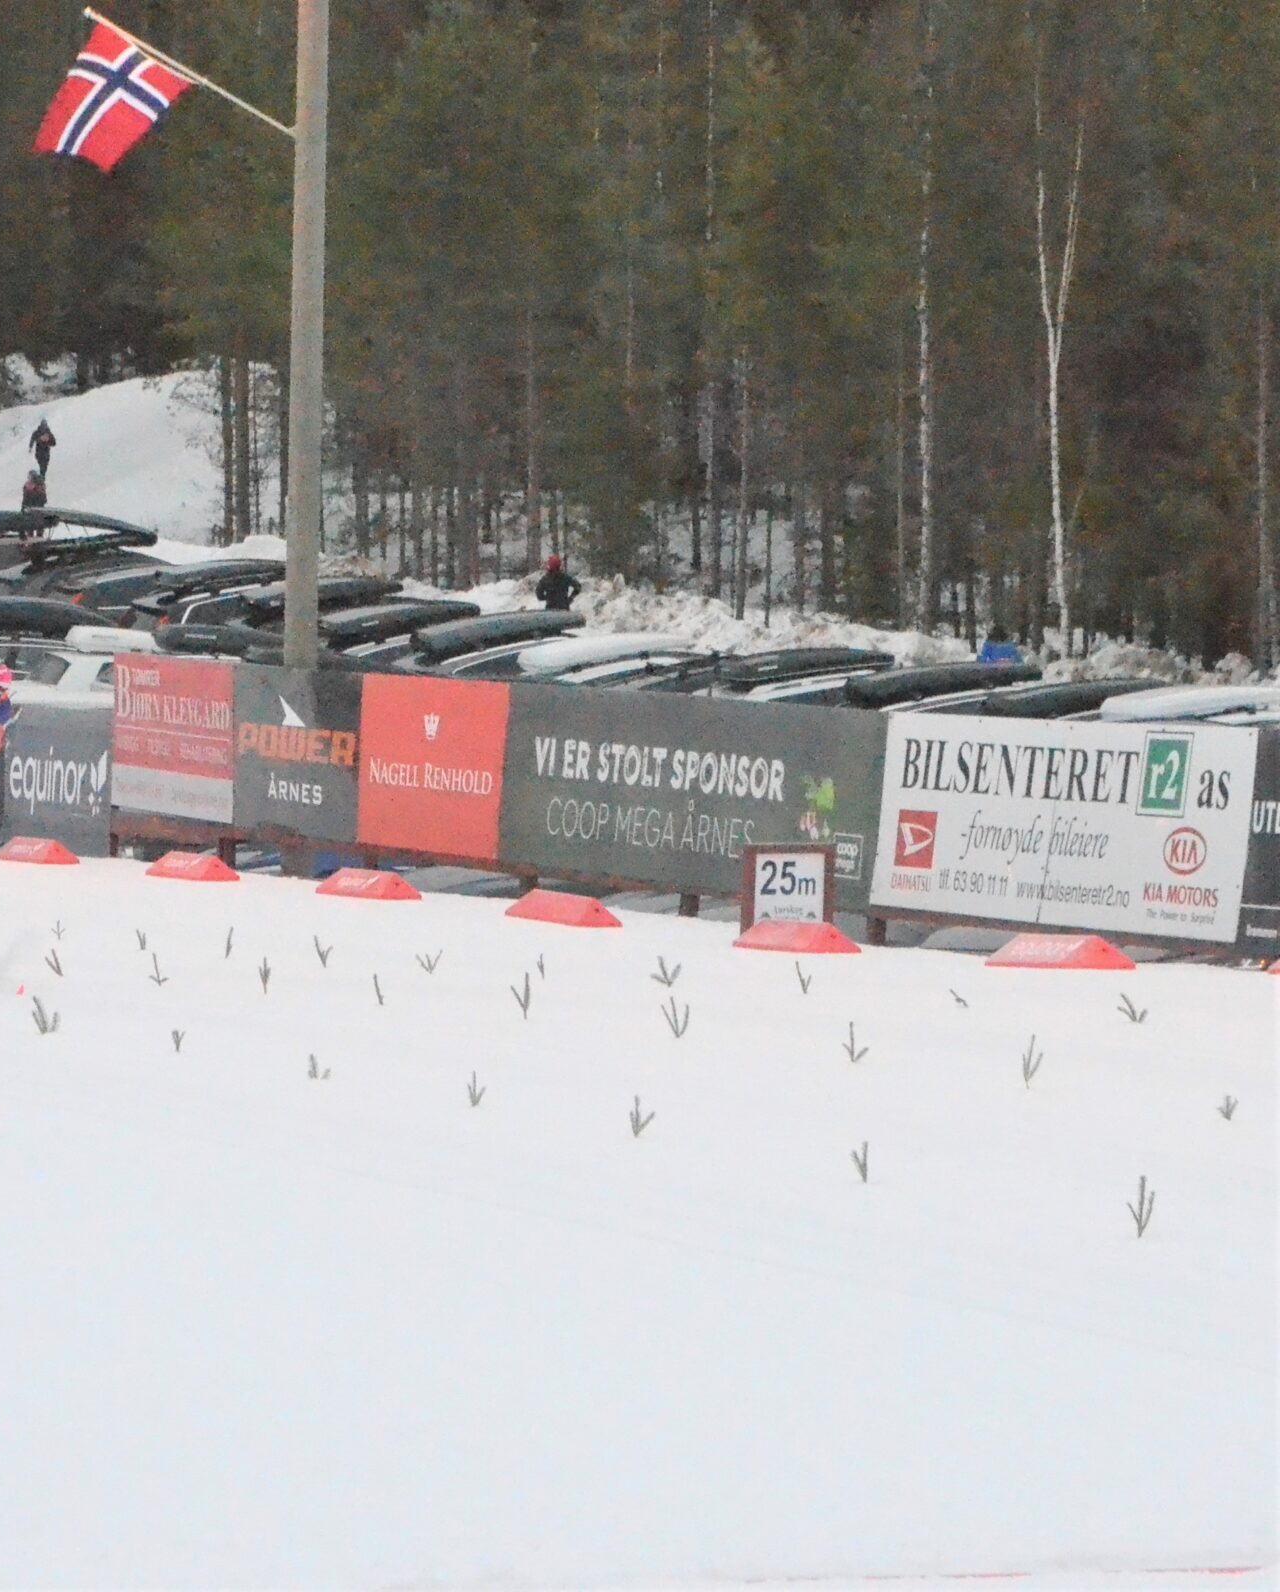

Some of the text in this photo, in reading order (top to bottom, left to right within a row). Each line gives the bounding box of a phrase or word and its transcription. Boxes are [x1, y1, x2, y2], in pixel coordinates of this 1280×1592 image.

[238, 722, 357, 766] POWER
[9, 747, 87, 816] equinor
[267, 773, 323, 805] ÅRNES
[369, 757, 493, 795] NAGELL RENHOLD
[535, 736, 784, 802] VI ER STOLT SPONSOR
[900, 738, 1231, 810] BILSENTERET r2 as
[547, 798, 756, 859] COOP MEGA ÅRNES
[1048, 815, 1109, 859] bileiere
[1170, 838, 1198, 864] KIA
[760, 860, 817, 896] 25m
[890, 872, 932, 893] DAIHATSU
[953, 869, 968, 893] 63
[969, 872, 984, 895] 90
[1016, 880, 1130, 909] www.bilsenteretr2.no
[1143, 881, 1219, 908] KIA MOTORS
